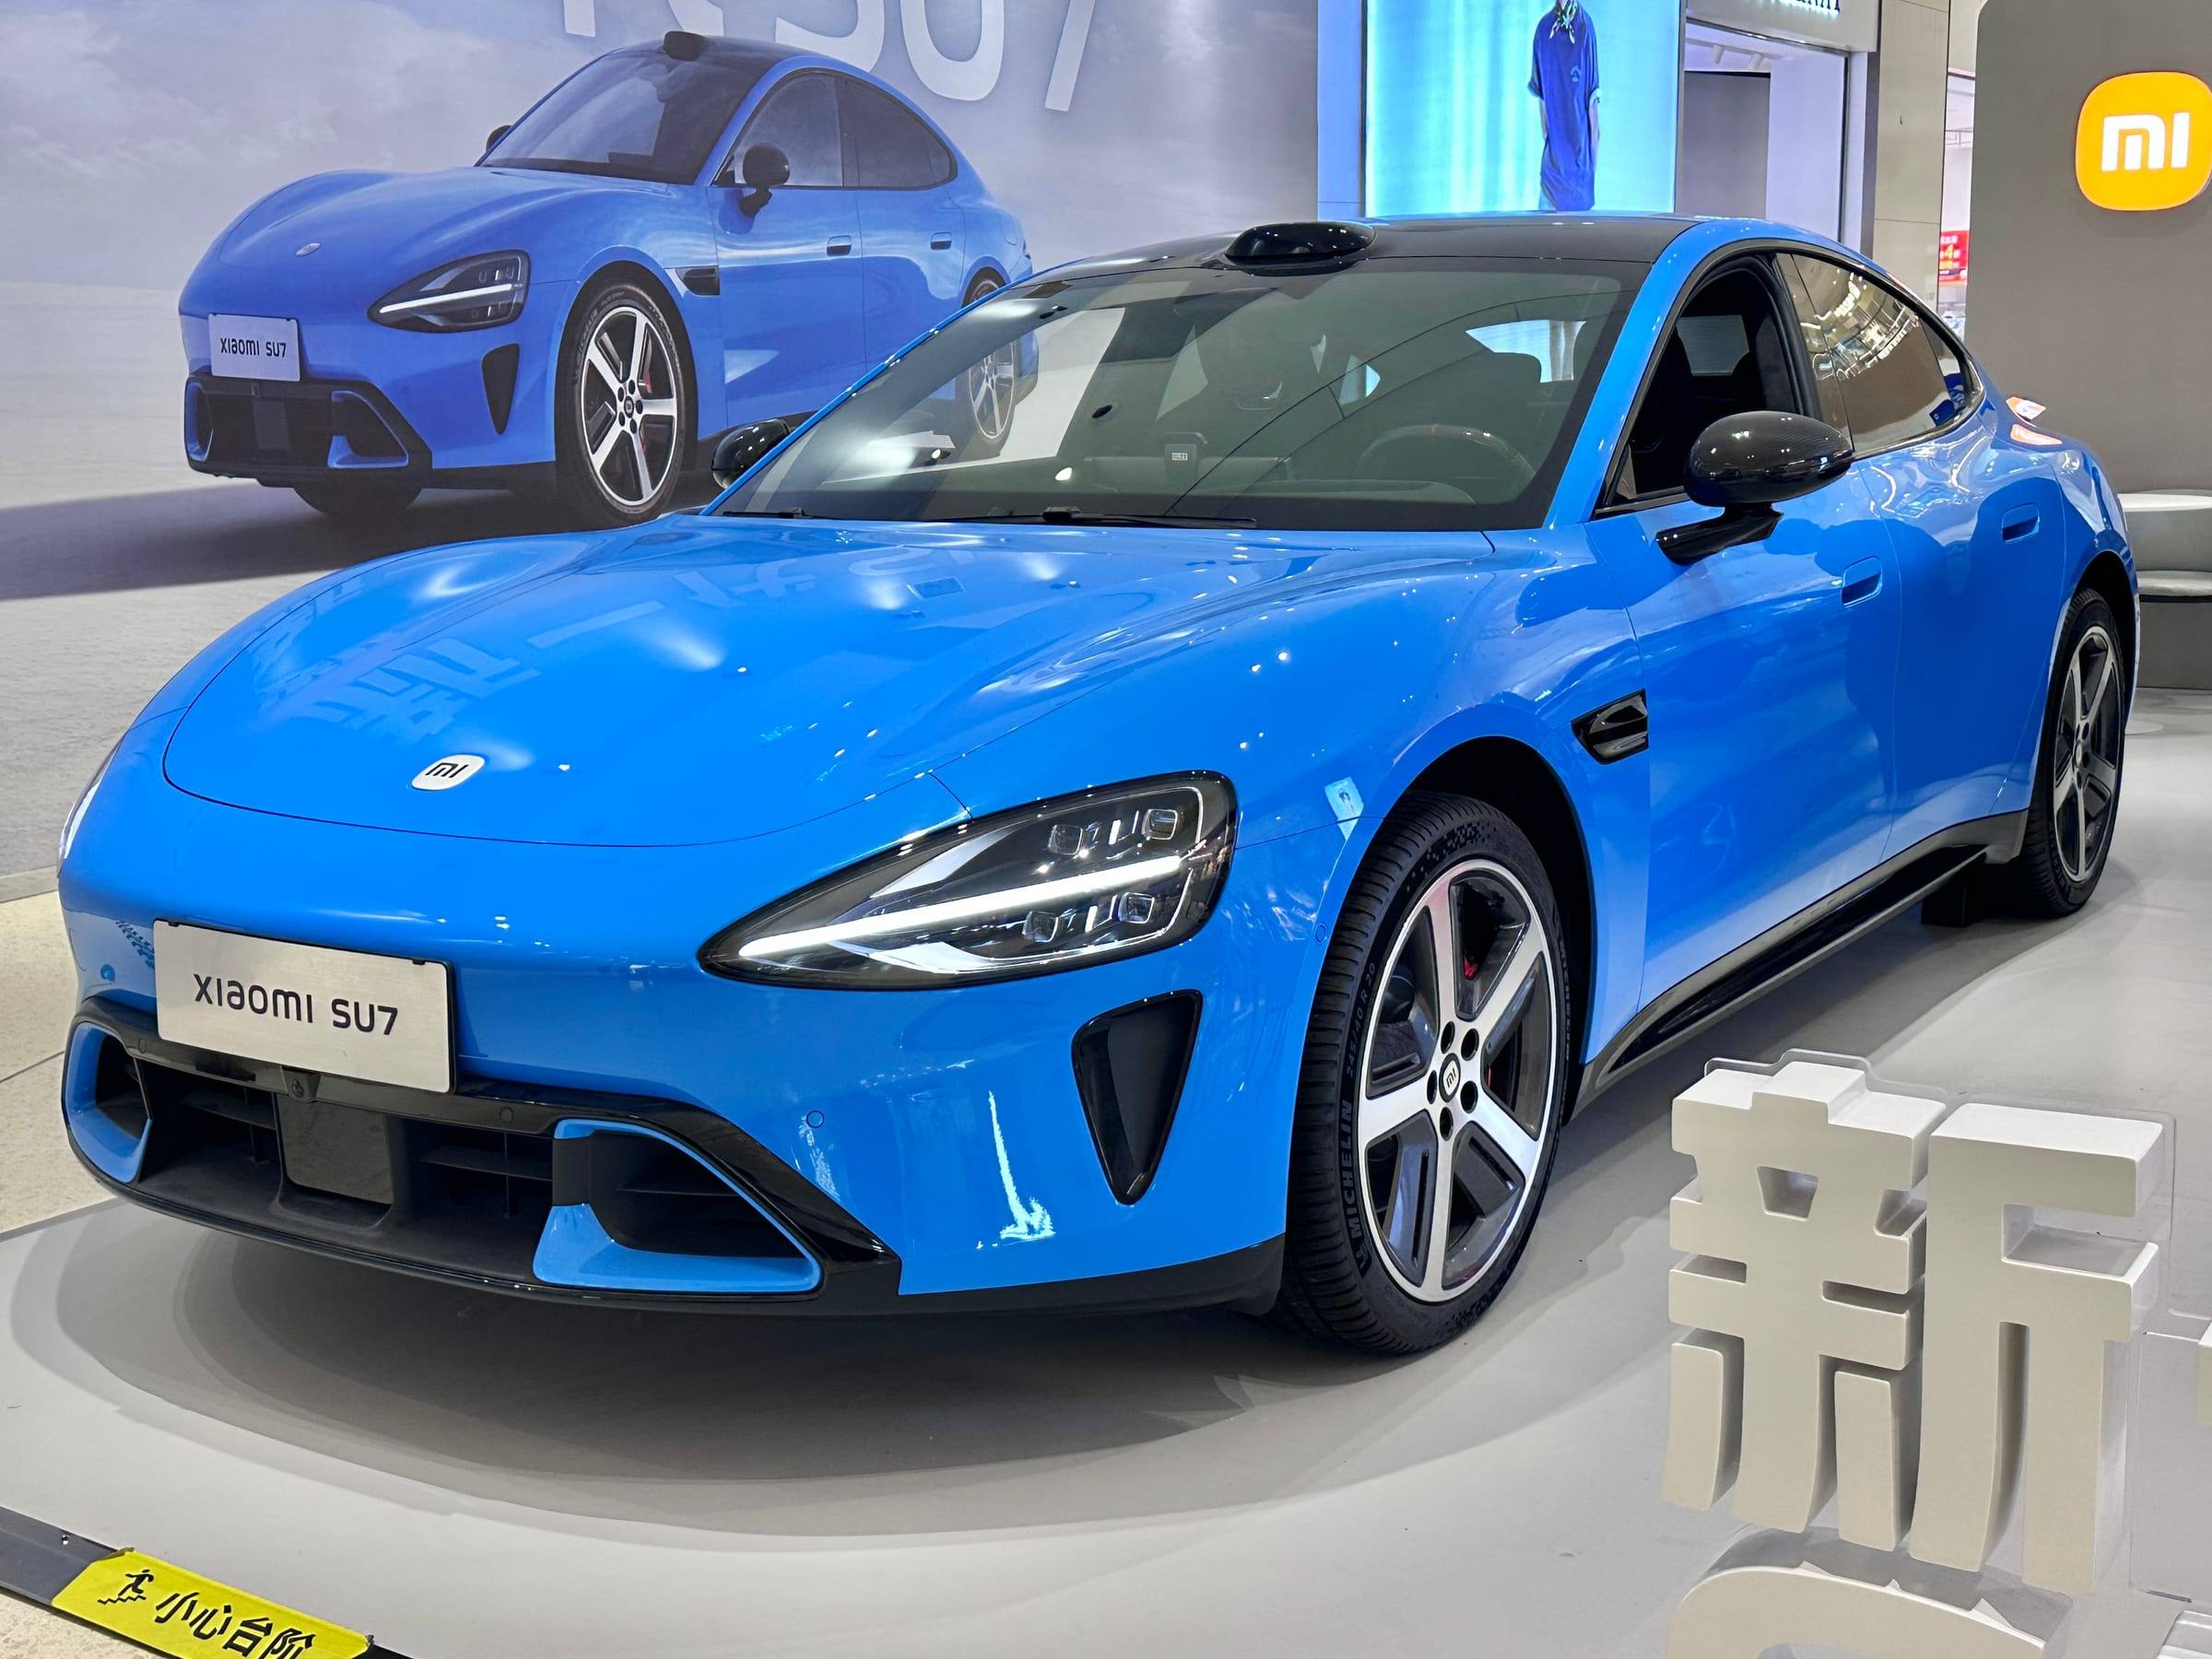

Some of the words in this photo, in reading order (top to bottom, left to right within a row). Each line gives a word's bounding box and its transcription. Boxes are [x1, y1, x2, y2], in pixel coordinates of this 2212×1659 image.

[265, 341, 287, 358] SU7
[331, 998, 399, 1036] SU7
[1339, 1100, 1363, 1240] MICHELIN
[1663, 1061, 2212, 1593] 新
[154, 1591, 317, 1659] 小心台阶
